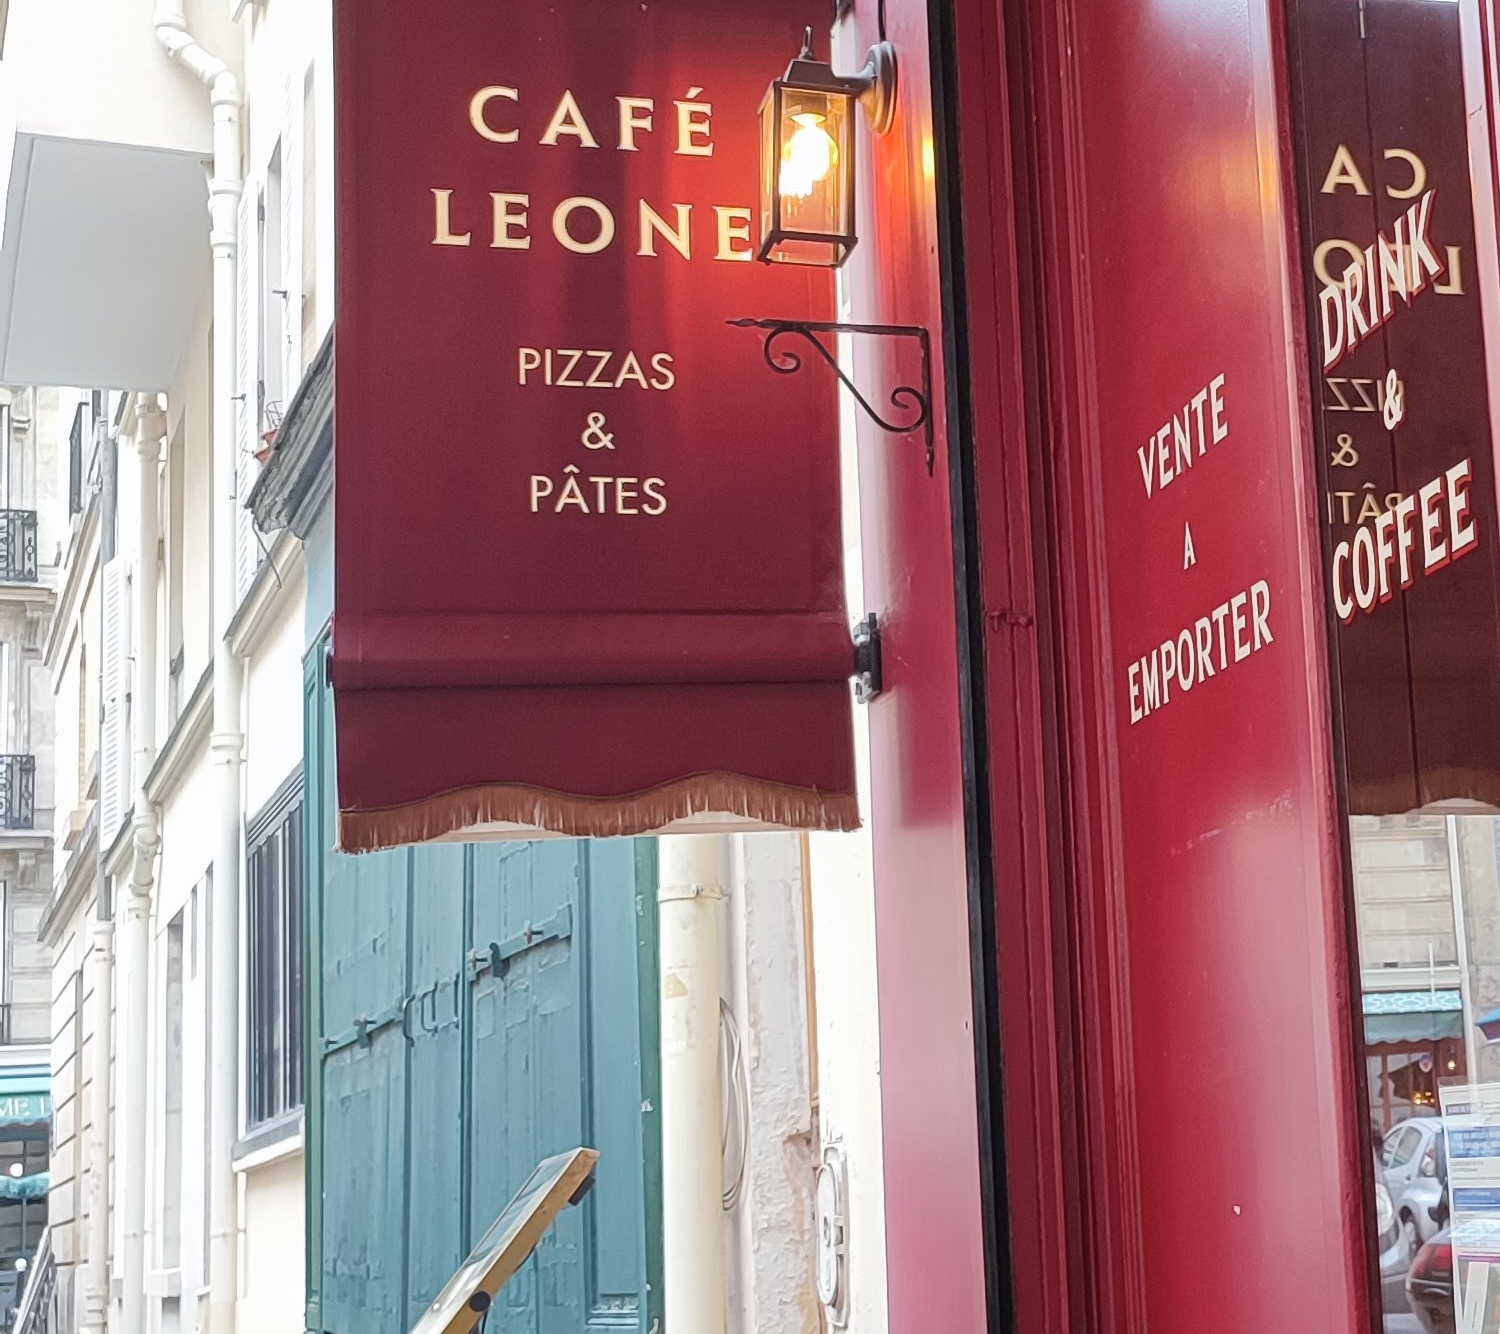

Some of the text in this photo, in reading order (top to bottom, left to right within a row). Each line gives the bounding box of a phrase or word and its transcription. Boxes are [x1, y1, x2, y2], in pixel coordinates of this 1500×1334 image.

[468, 85, 714, 157] CAFÉ
[430, 188, 753, 261] LEONE
[1319, 188, 1444, 374] DRINK
[519, 348, 675, 390] PIZZAS
[1383, 369, 1404, 431] &
[581, 411, 615, 449] &
[1137, 373, 1229, 499] VENTE
[530, 463, 667, 515] PÂTES
[1183, 521, 1197, 570] A
[1333, 457, 1478, 624] COFFEE
[1128, 579, 1274, 725] EMPORTER
